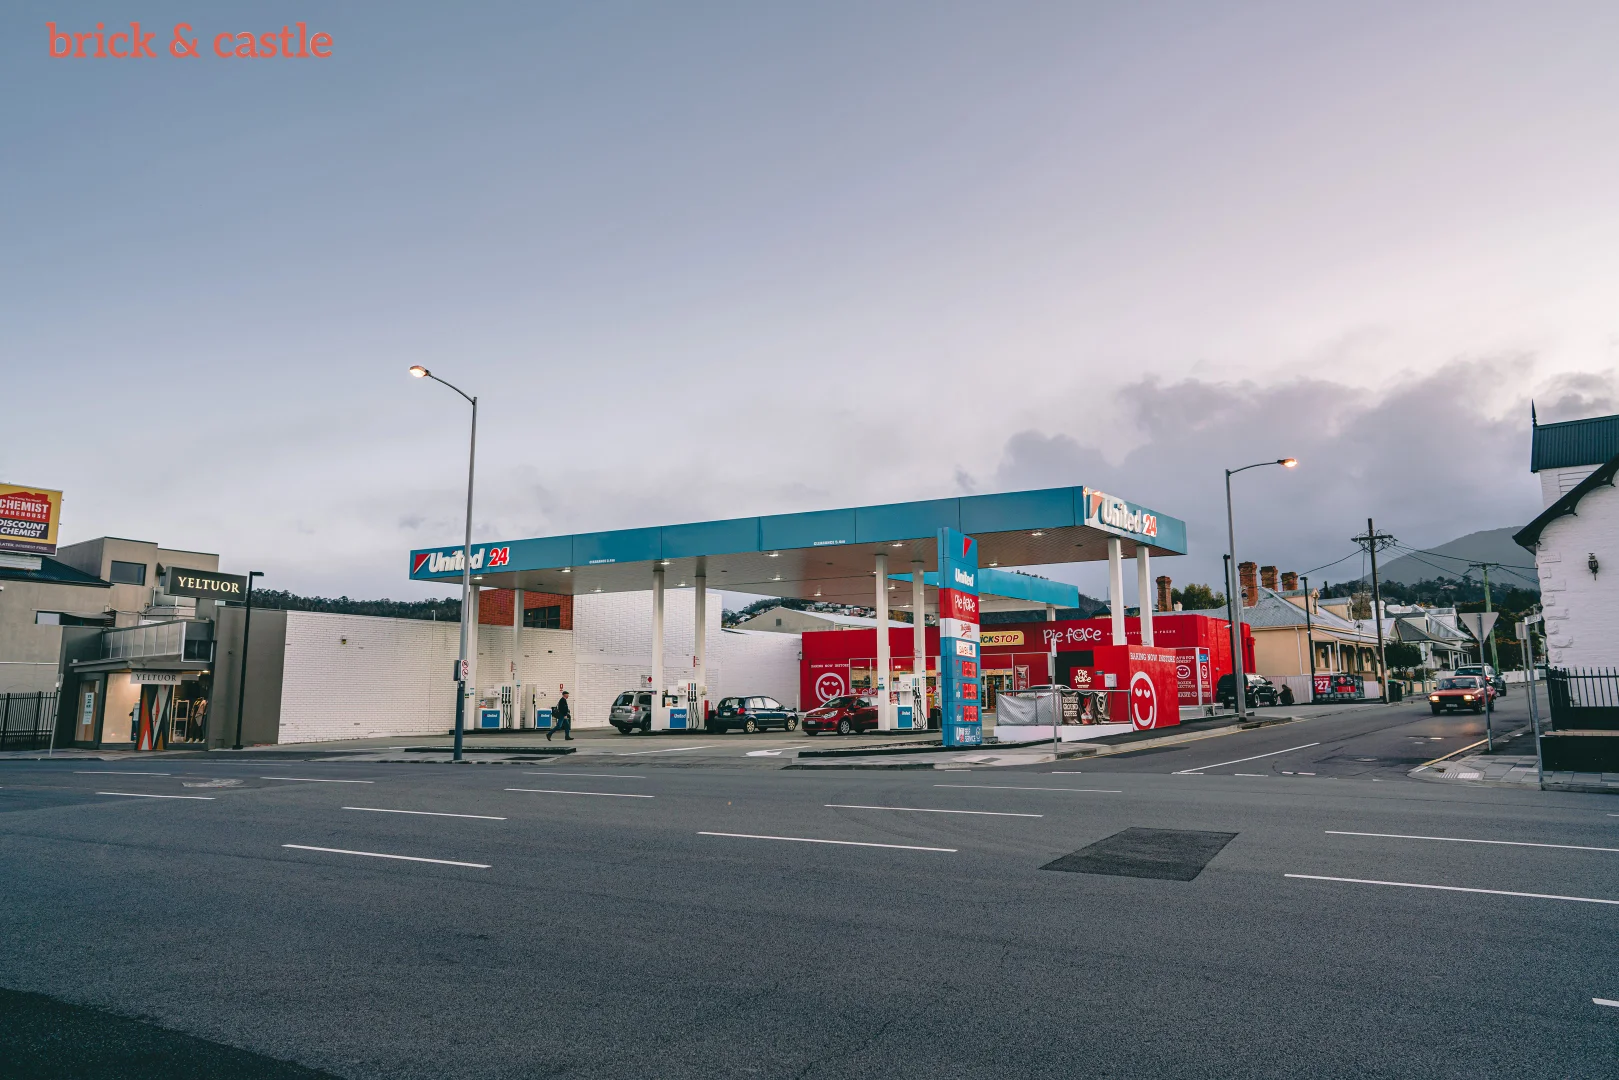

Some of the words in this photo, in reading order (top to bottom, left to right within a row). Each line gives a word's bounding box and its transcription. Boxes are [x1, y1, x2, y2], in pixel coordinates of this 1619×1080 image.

[0, 499, 49, 513] CHEMIST
[0, 519, 46, 531] DISCOUNT
[1101, 500, 1141, 533] United
[1143, 513, 1157, 537] 24
[0, 527, 41, 537] CHEMIST
[487, 546, 510, 567] 24
[955, 567, 974, 587] United
[178, 576, 240, 593] YELTUOR
[1130, 652, 1146, 661] BAKING
[1147, 653, 1157, 661] NOW
[136, 674, 177, 682] YELTUOR
